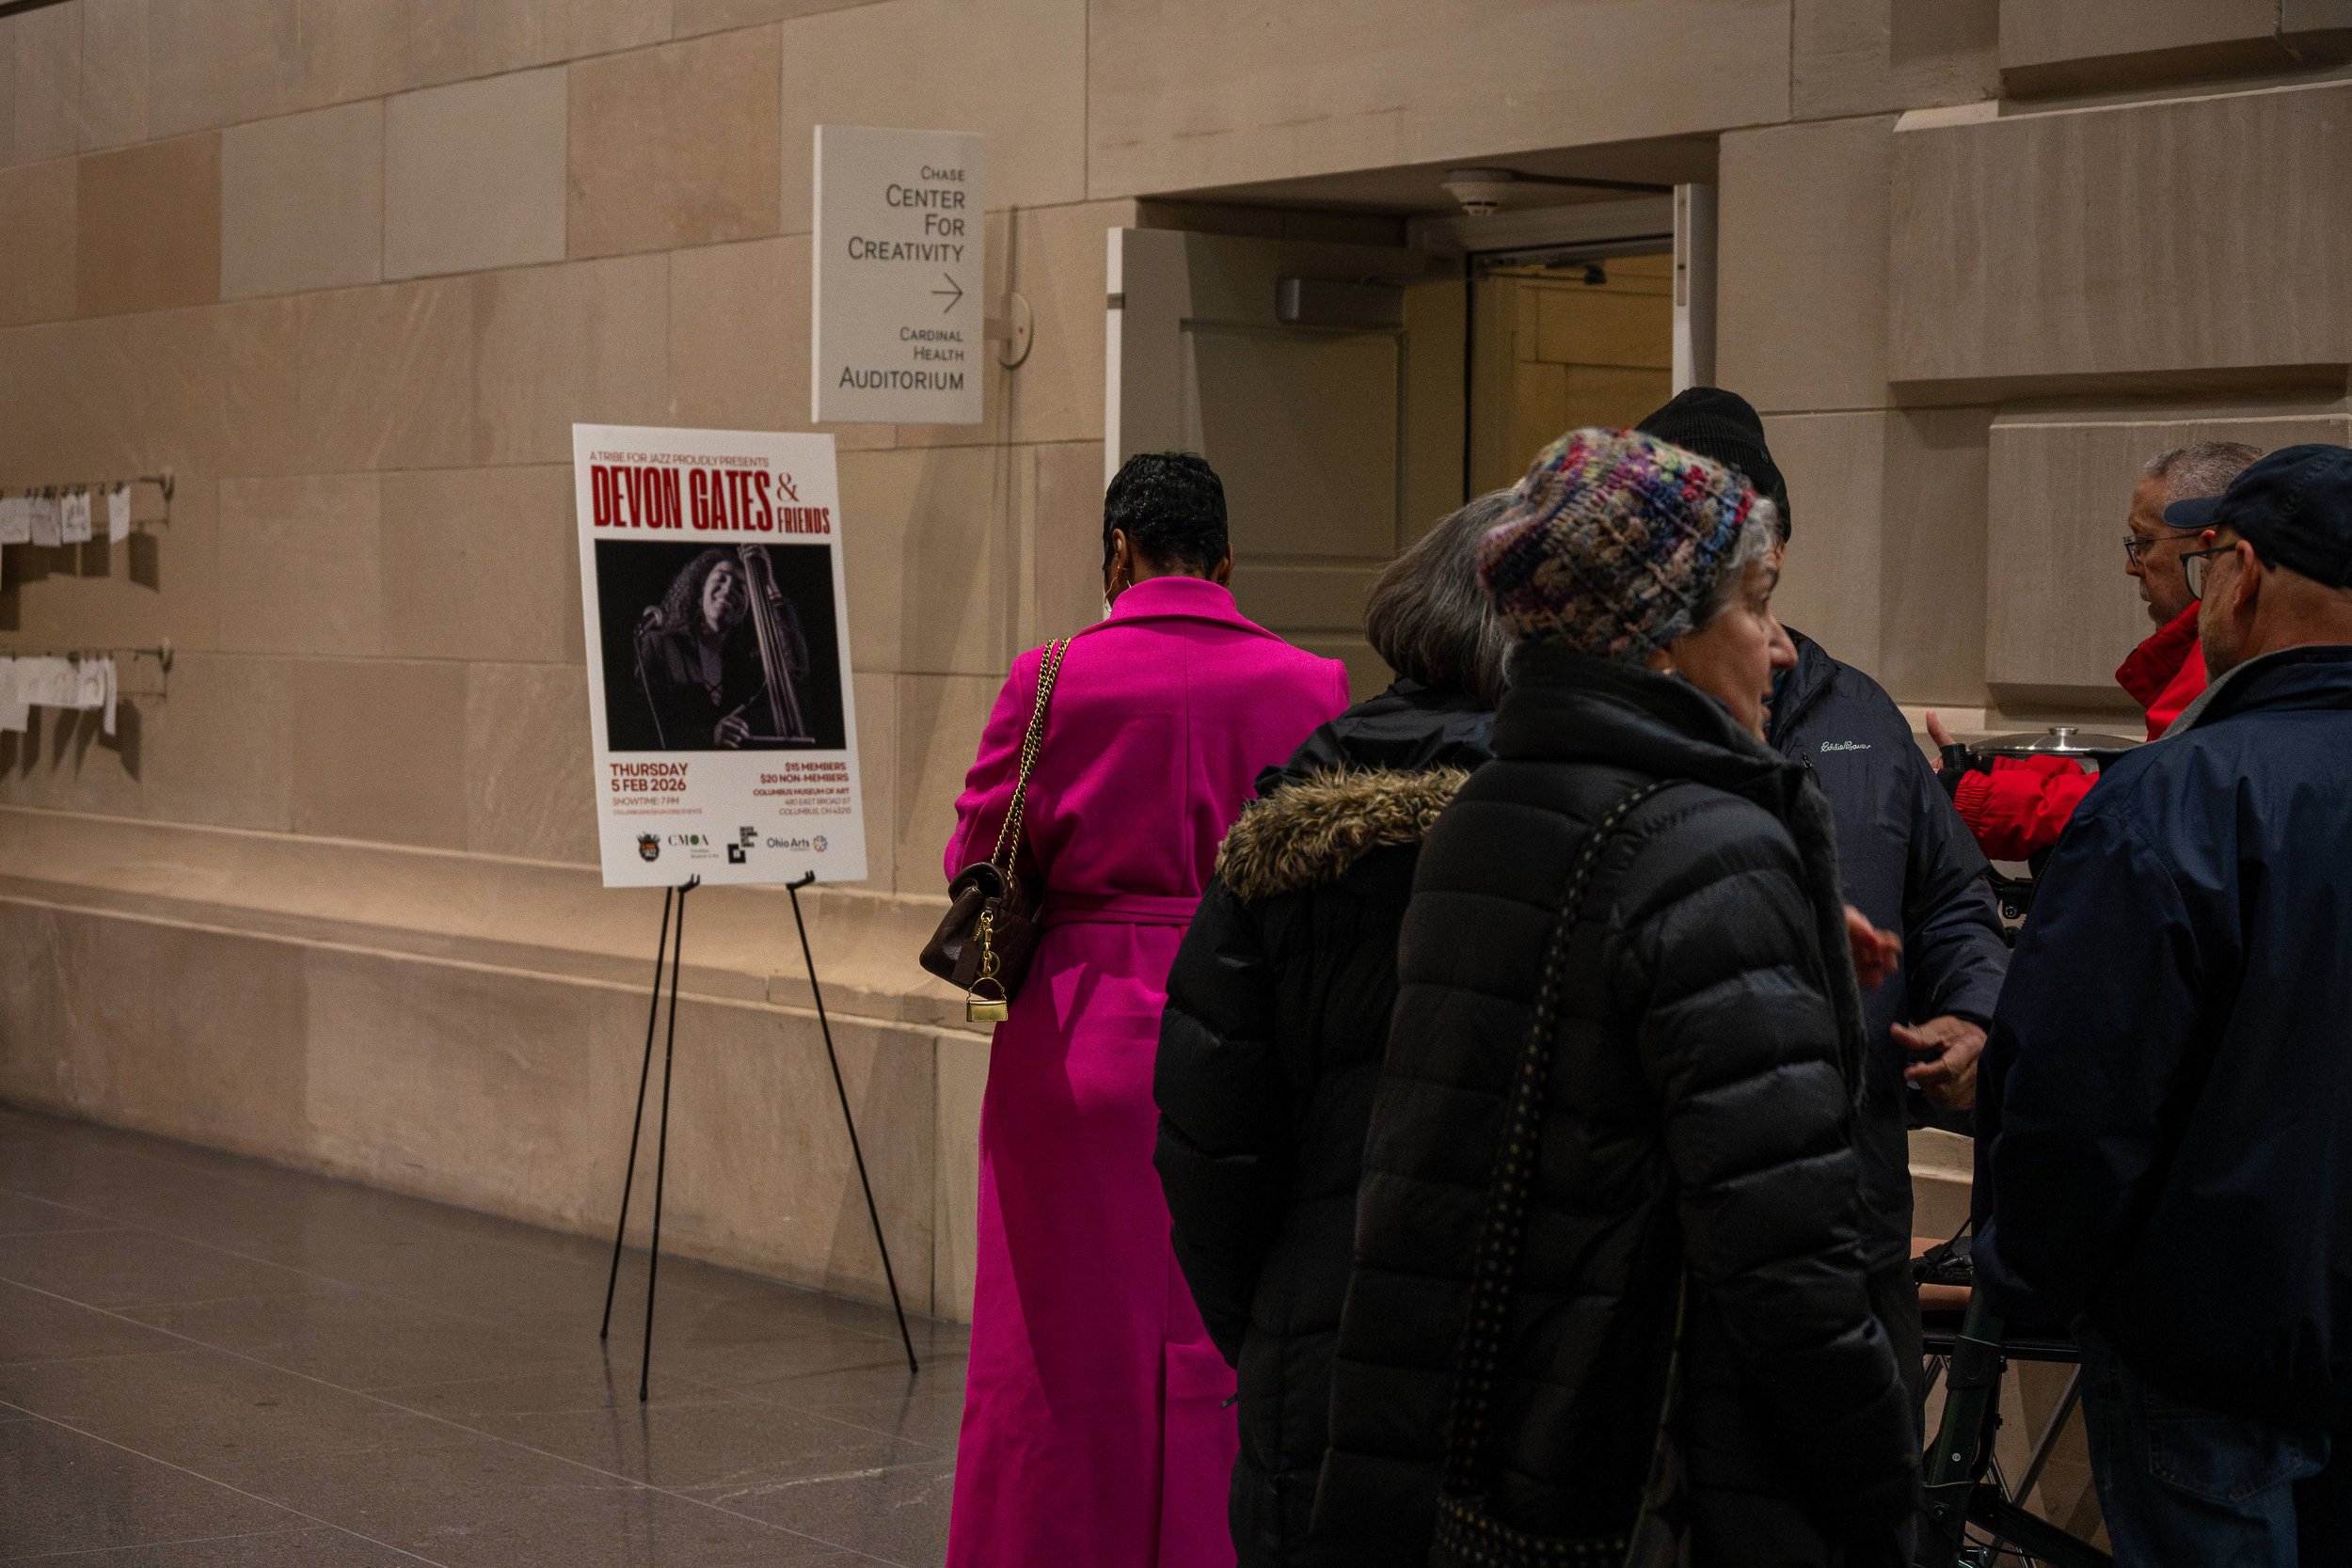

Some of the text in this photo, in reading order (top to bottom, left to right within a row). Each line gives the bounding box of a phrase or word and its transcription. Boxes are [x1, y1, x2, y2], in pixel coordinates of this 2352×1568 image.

[885, 183, 965, 209] CENTER
[925, 214, 964, 236] FOR
[848, 236, 964, 262] CREATIVITY
[839, 366, 963, 390] AUDITORIUM
[589, 451, 770, 467] A TRIBE FOR JAZZ PROUDLY PRESENTS
[591, 465, 800, 532] DEVON GATES &
[777, 506, 832, 534] FRIENDS
[610, 763, 689, 777] THURSDAY
[785, 762, 847, 771] $15 MEMBERS
[612, 779, 687, 792] 5 FEB 2026
[760, 772, 850, 784] $20 NON-MEMBERS
[753, 788, 793, 797] COLUMBUS
[835, 786, 850, 795] ART
[766, 837, 810, 848] Ohio Arts
